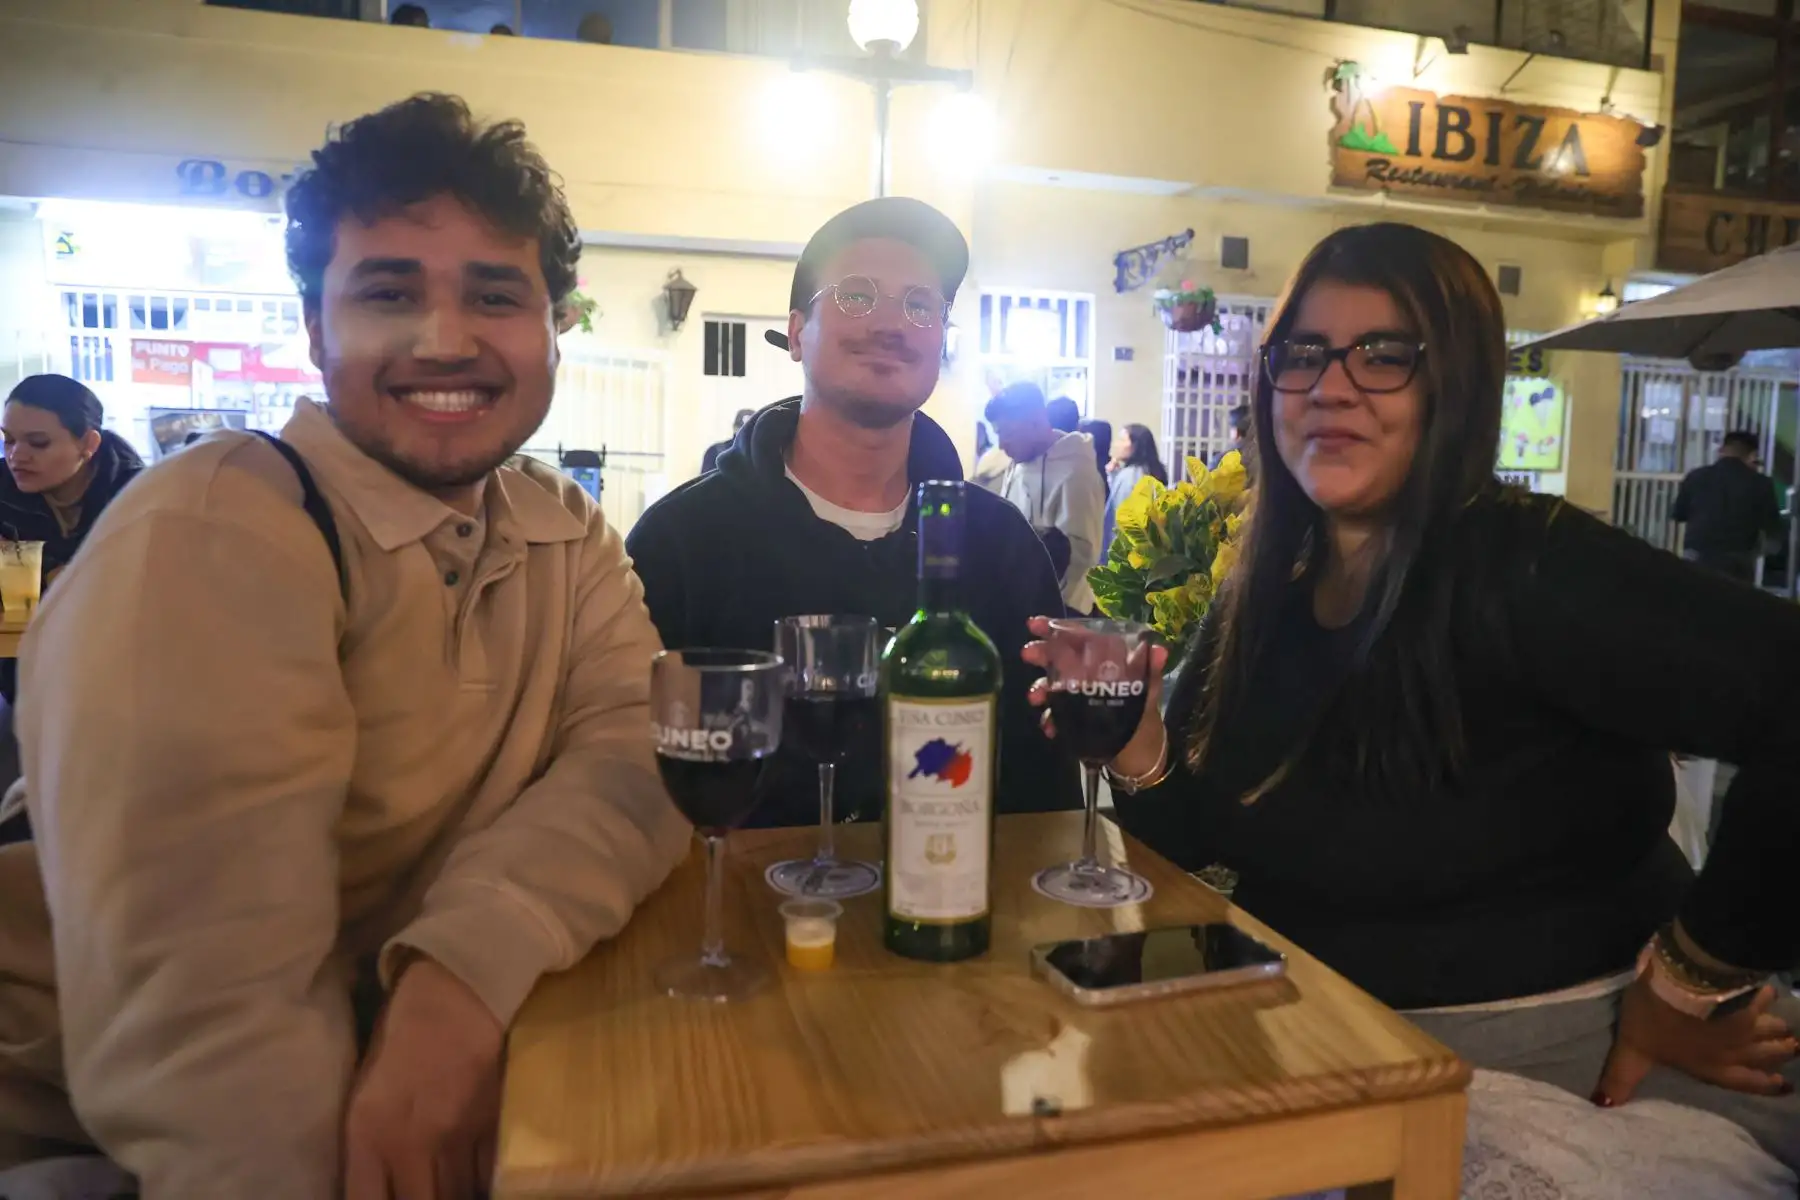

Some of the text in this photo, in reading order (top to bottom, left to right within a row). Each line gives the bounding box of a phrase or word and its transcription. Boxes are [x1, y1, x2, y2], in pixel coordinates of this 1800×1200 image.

[1406, 100, 1590, 177] IBIZA
[135, 341, 190, 357] PUNTO
[1066, 680, 1144, 697] CUNEO
